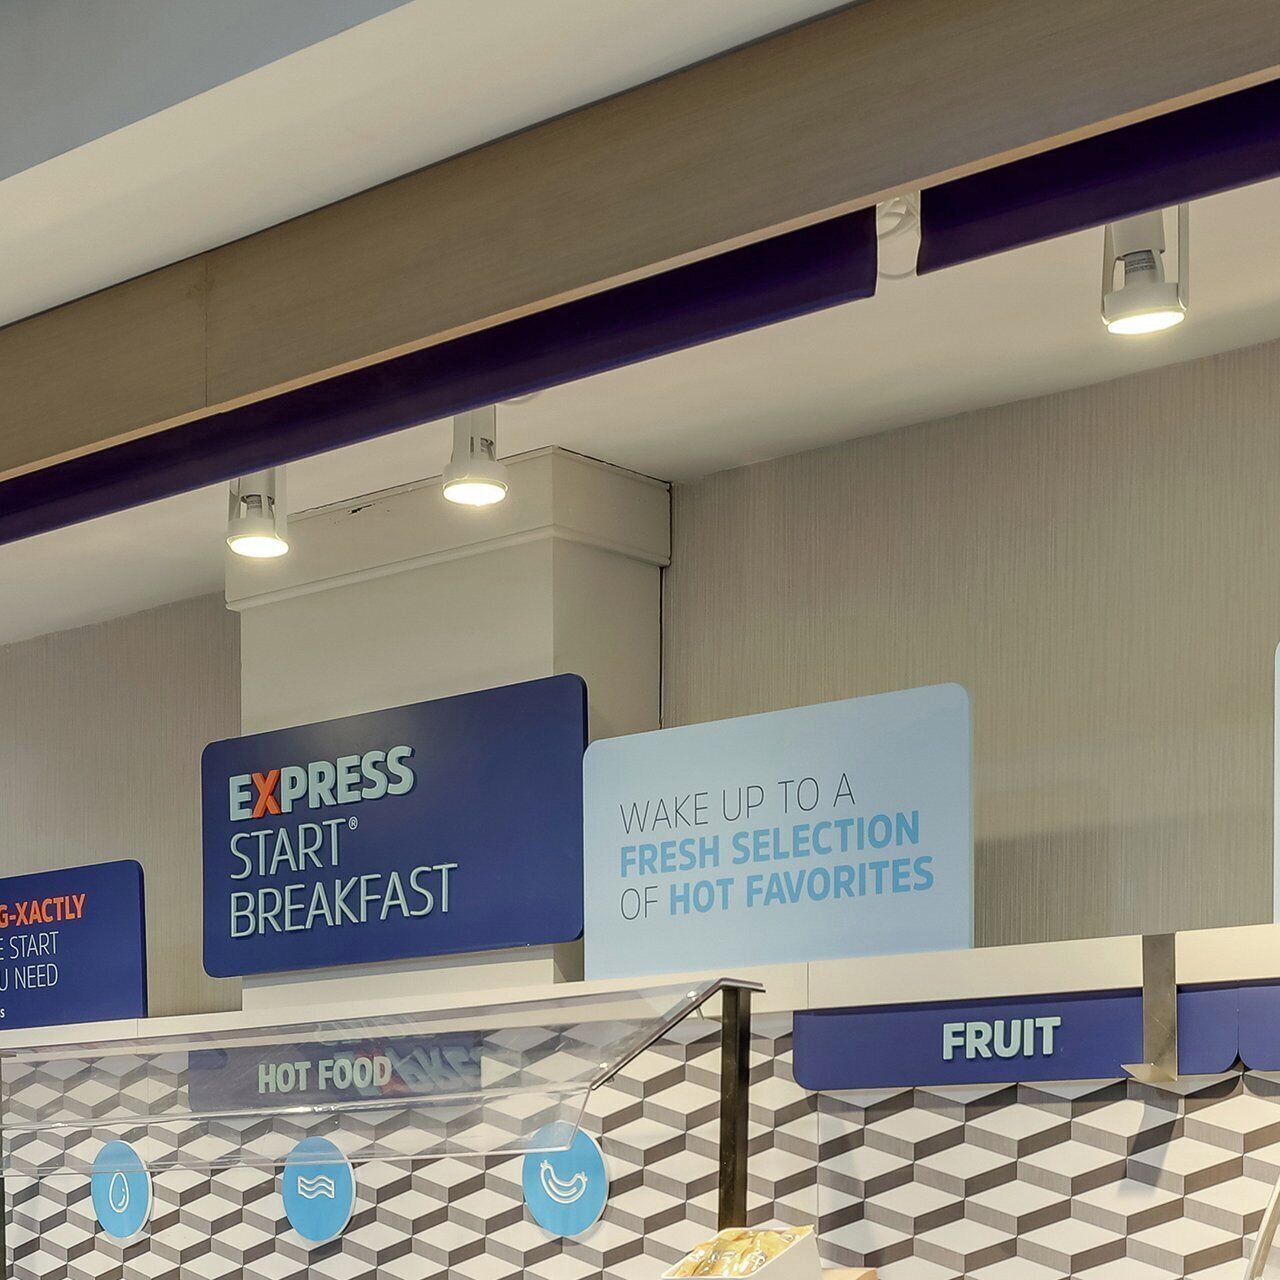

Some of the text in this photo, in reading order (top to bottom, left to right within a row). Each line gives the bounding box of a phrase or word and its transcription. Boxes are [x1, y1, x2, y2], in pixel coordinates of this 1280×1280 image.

[229, 744, 416, 822] EXPRESS
[620, 772, 856, 835] WAKE UP TO A
[620, 809, 920, 878] FRESH SELECTION
[229, 862, 458, 938] BREAKFAST
[620, 855, 935, 921] OF HOT FAVORITES
[9, 931, 59, 959] START
[15, 963, 59, 989] NEED
[942, 1016, 1061, 1061] FRUIT
[258, 1060, 311, 1094] HOT
[319, 1056, 393, 1090] FOOD
